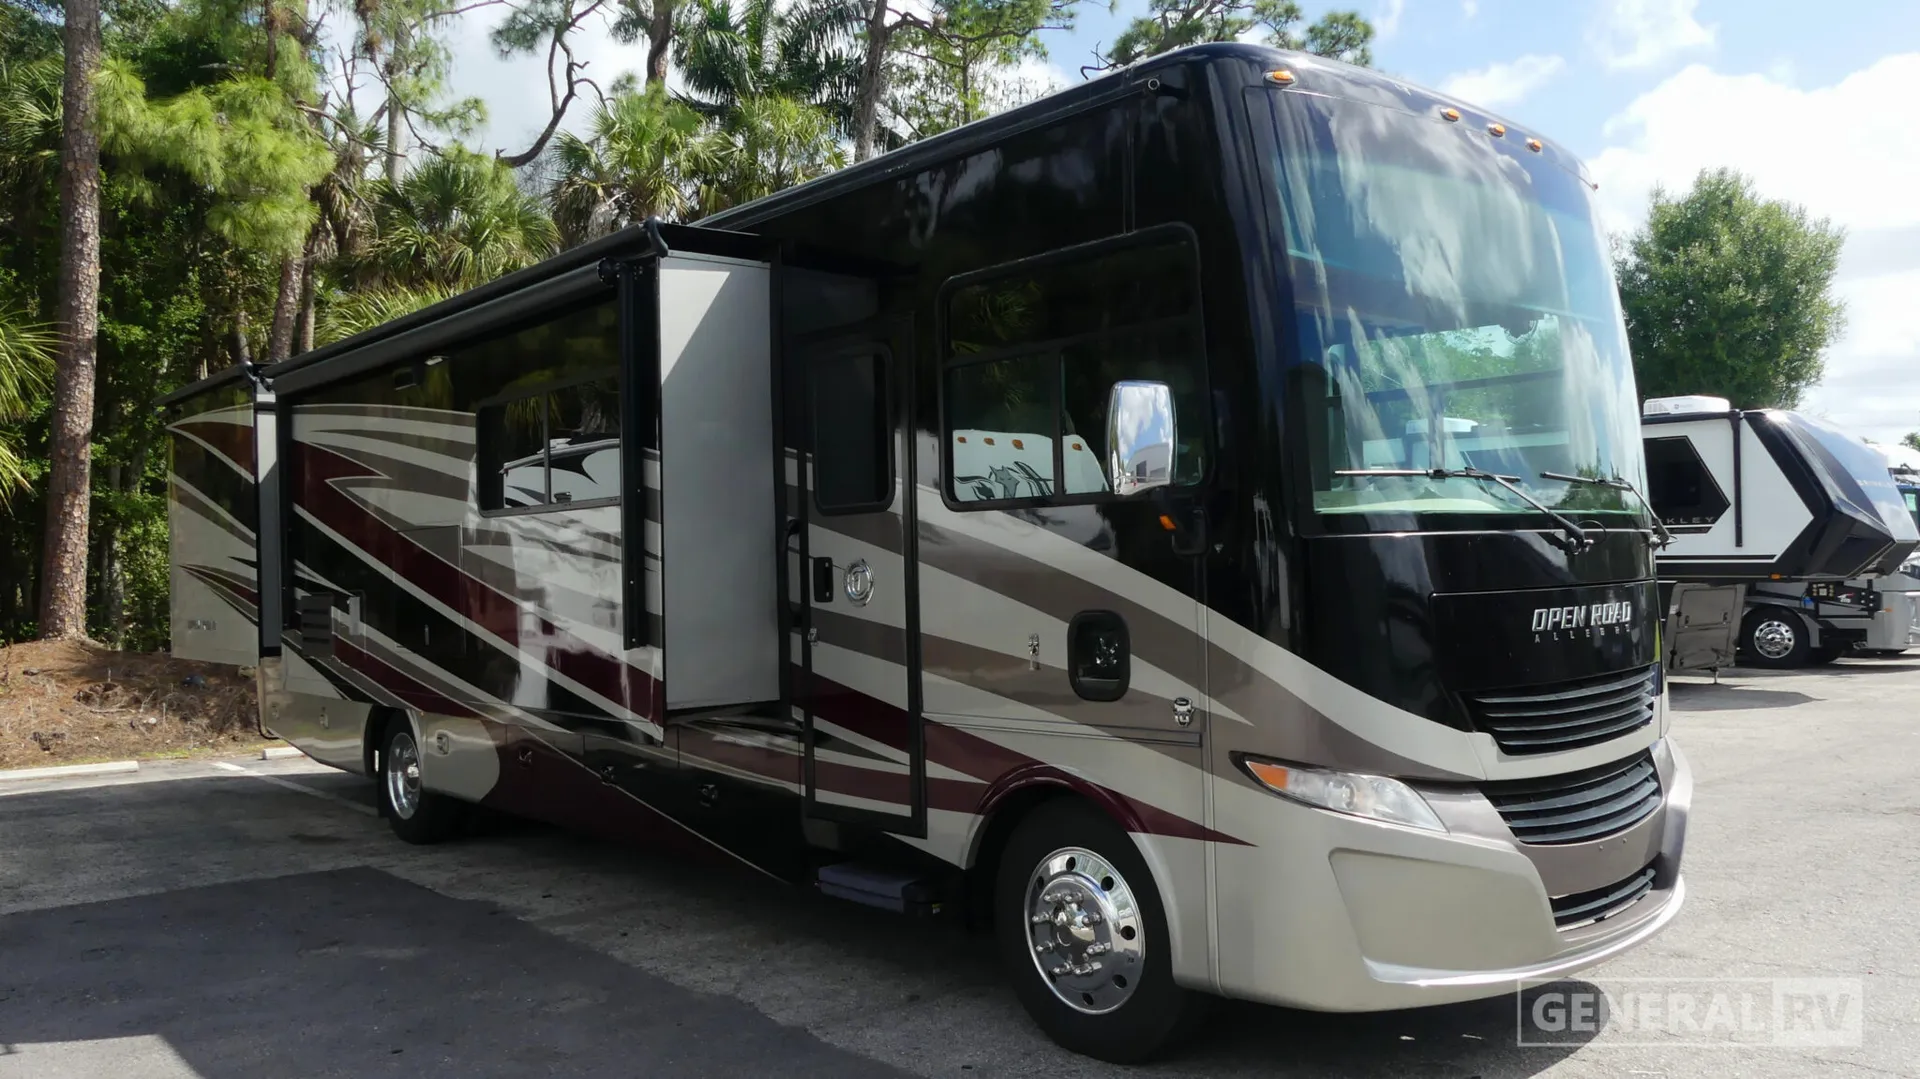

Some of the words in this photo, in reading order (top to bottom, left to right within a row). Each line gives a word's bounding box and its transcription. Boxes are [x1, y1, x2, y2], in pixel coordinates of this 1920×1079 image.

[1659, 516, 1714, 525] KLEY
[1531, 605, 1587, 632] OPEN
[1590, 601, 1632, 626] ROAD
